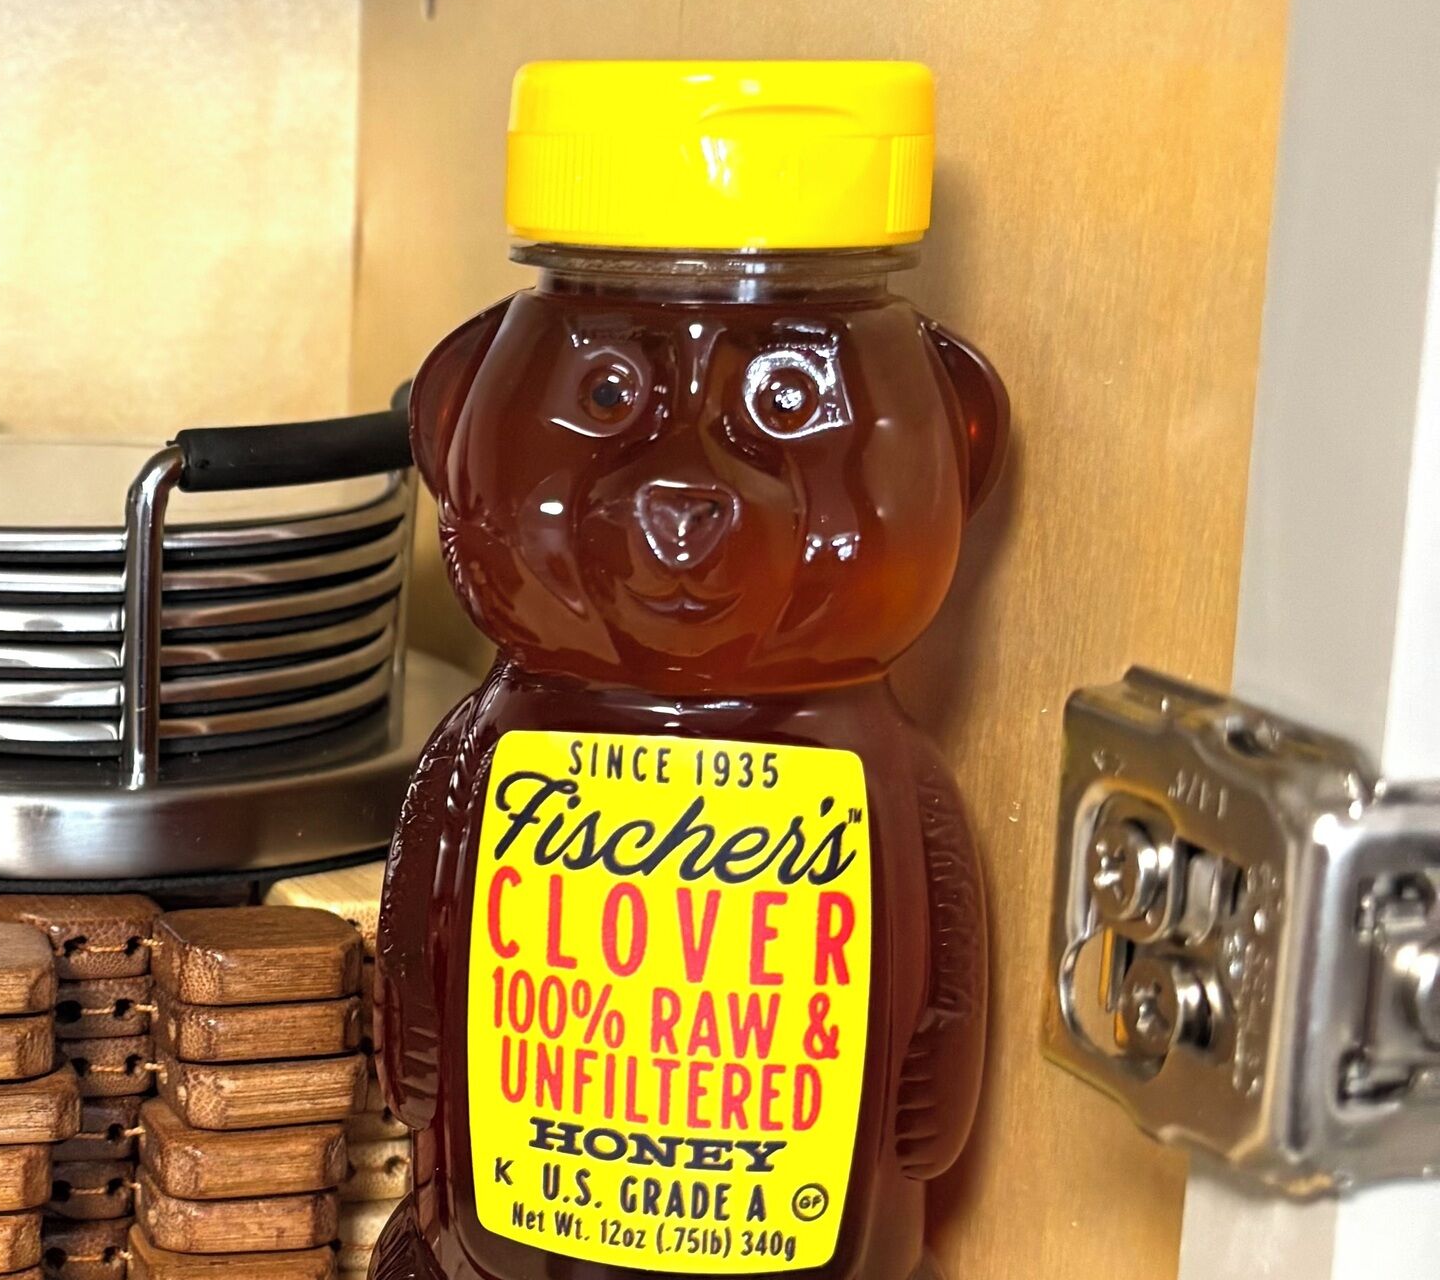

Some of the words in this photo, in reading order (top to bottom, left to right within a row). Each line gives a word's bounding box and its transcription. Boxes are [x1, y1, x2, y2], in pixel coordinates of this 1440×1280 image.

[568, 740, 671, 784] SINCE
[695, 751, 779, 789] 1935
[494, 771, 857, 886] Fischer's
[487, 865, 856, 986] CLOVER
[492, 966, 625, 1049] 100%
[650, 987, 781, 1060] RAW
[802, 992, 840, 1061] &
[500, 1035, 823, 1131] UNFILTERED
[528, 1116, 788, 1173] HONEY
[512, 1201, 545, 1233] Net
[554, 1210, 590, 1241] Wt.
[600, 1219, 646, 1249] 12oz
[741, 1230, 796, 1262] 340g
[542, 1162, 603, 1210] U.S.
[620, 1175, 732, 1221] GRADE
[746, 1184, 766, 1223] A
